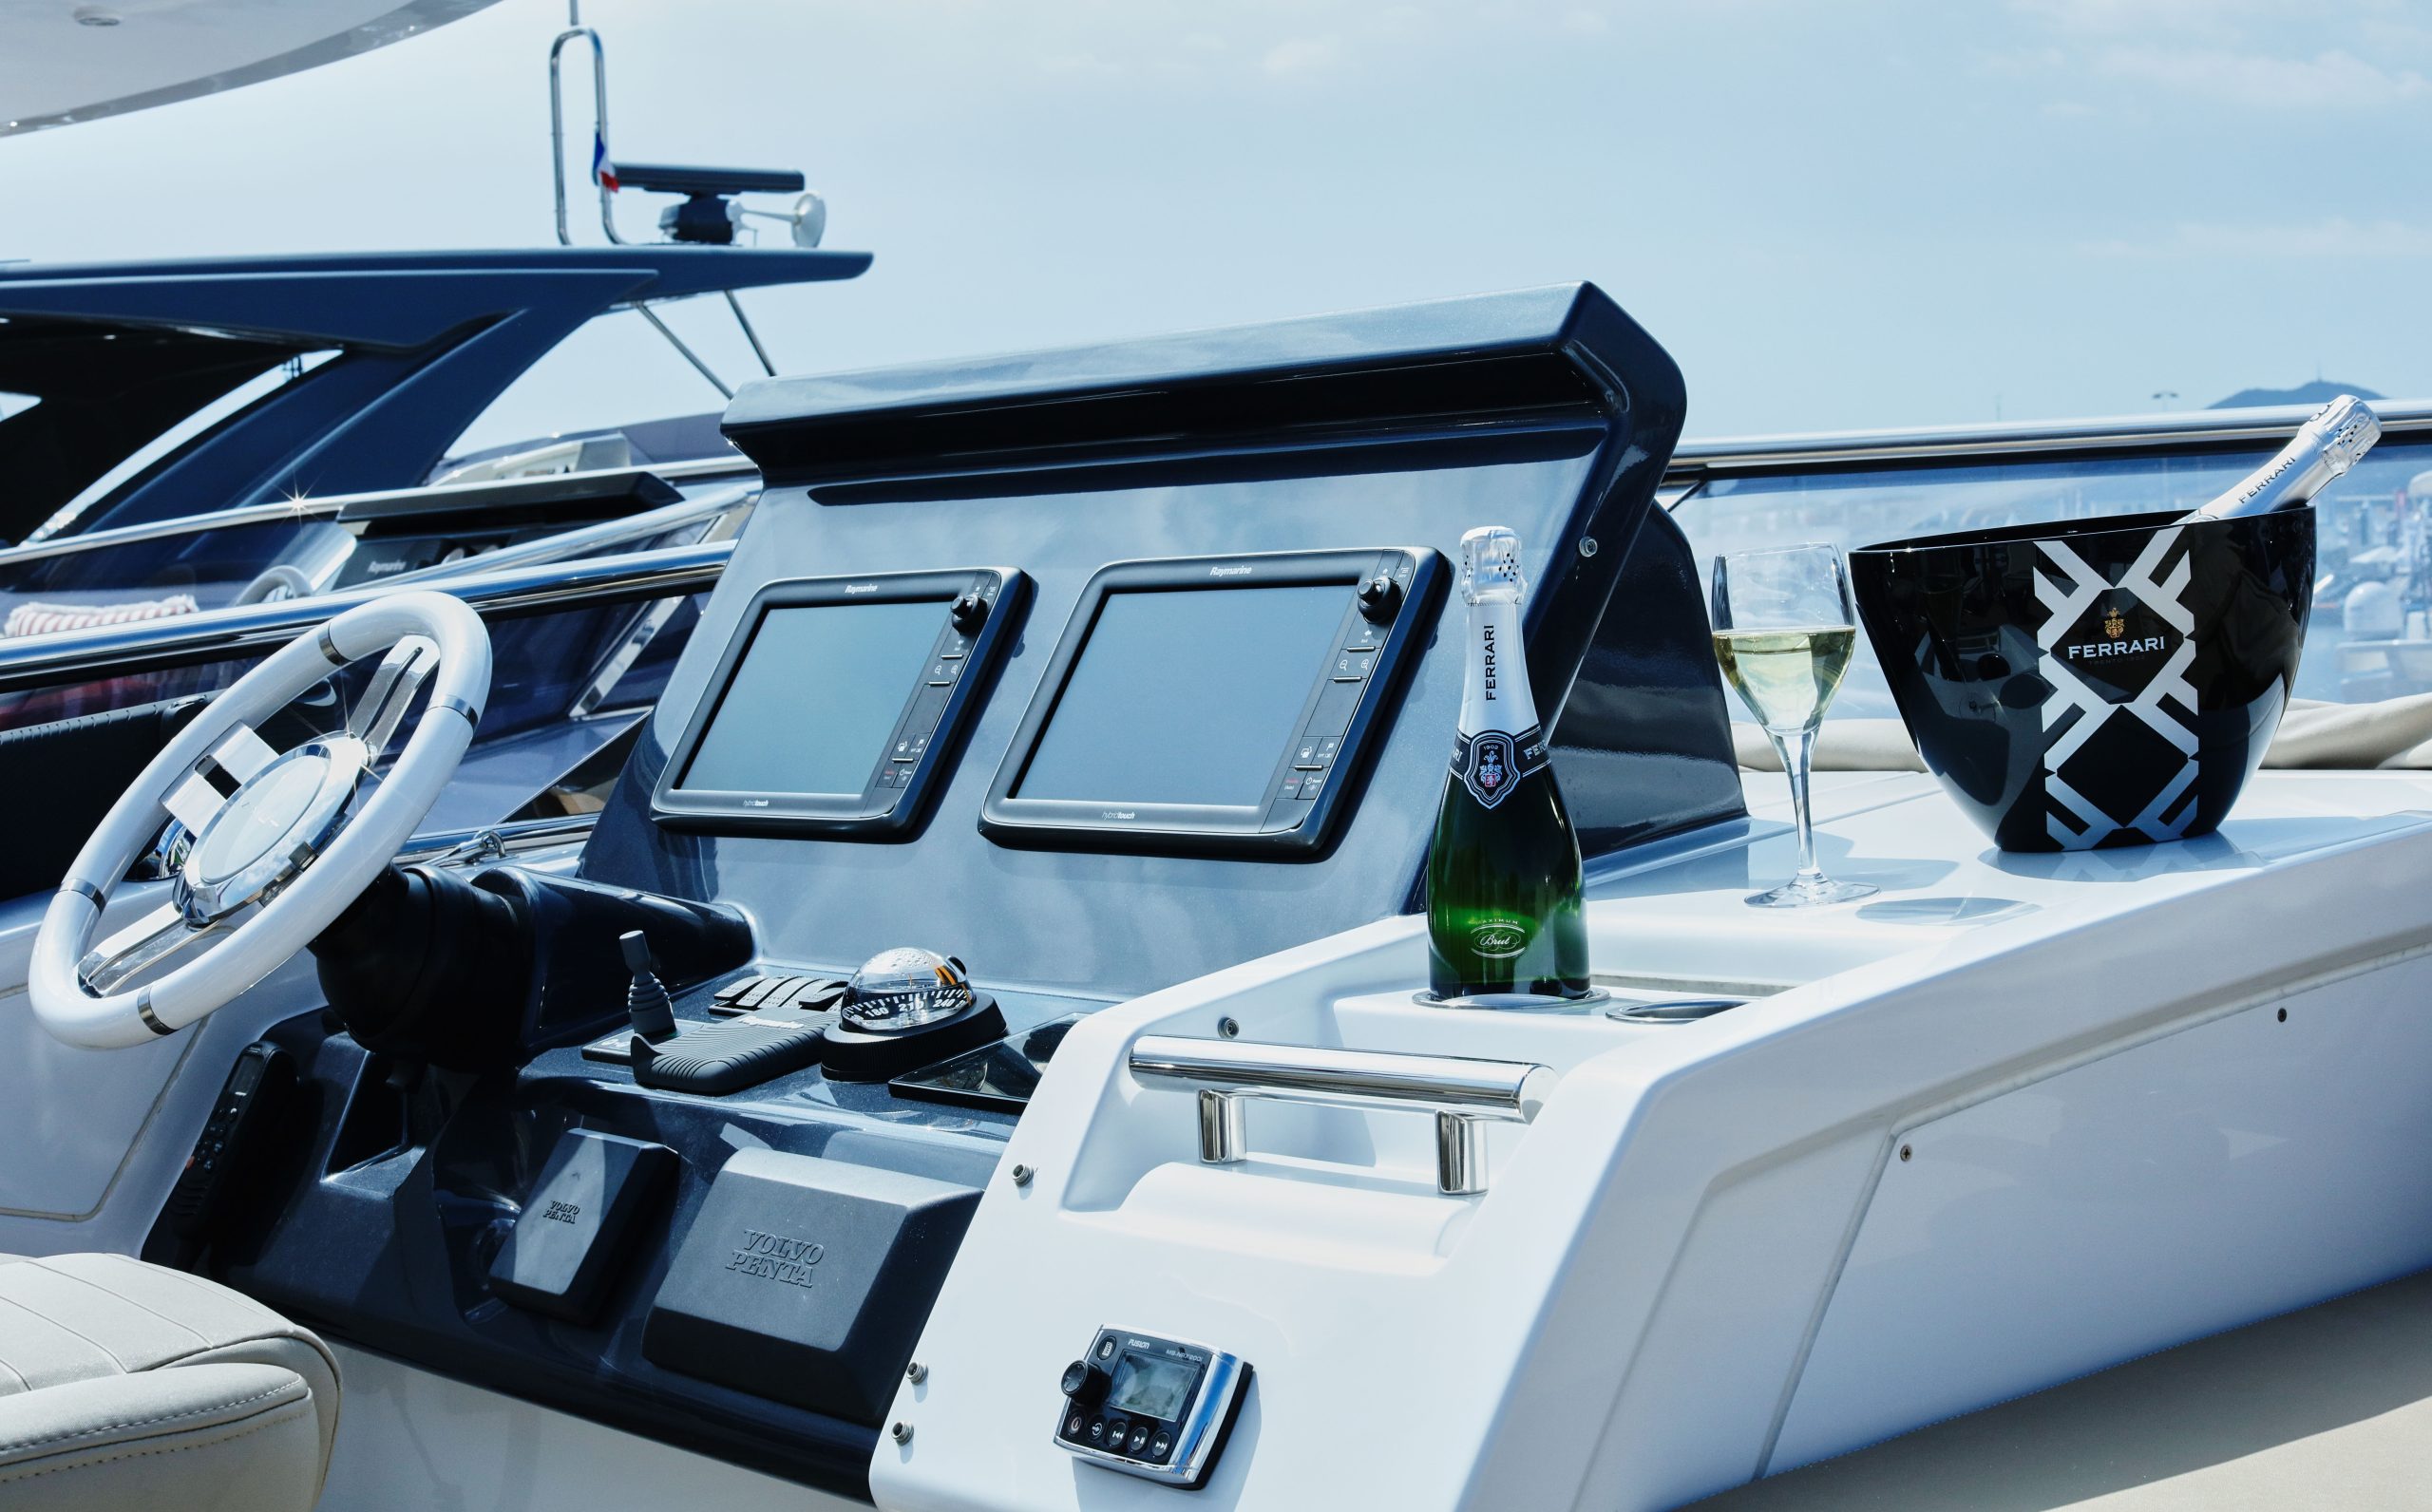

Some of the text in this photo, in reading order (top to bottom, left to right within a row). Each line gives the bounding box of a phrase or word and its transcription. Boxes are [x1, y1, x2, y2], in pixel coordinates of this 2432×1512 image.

[2238, 457, 2296, 504] FERRARI
[1209, 565, 1252, 577] Raymarine
[2067, 635, 2165, 660] FERRARI
[1483, 624, 1496, 701] FERRARI
[1479, 934, 1511, 946] Brut
[864, 1007, 890, 1017] 180
[898, 1000, 924, 1012] 210
[933, 998, 956, 1008] 240
[550, 1200, 580, 1216] VOLVO
[744, 1228, 825, 1265] VOLVO
[725, 1249, 813, 1289] PENTA
[1128, 1338, 1150, 1350] FUSION
